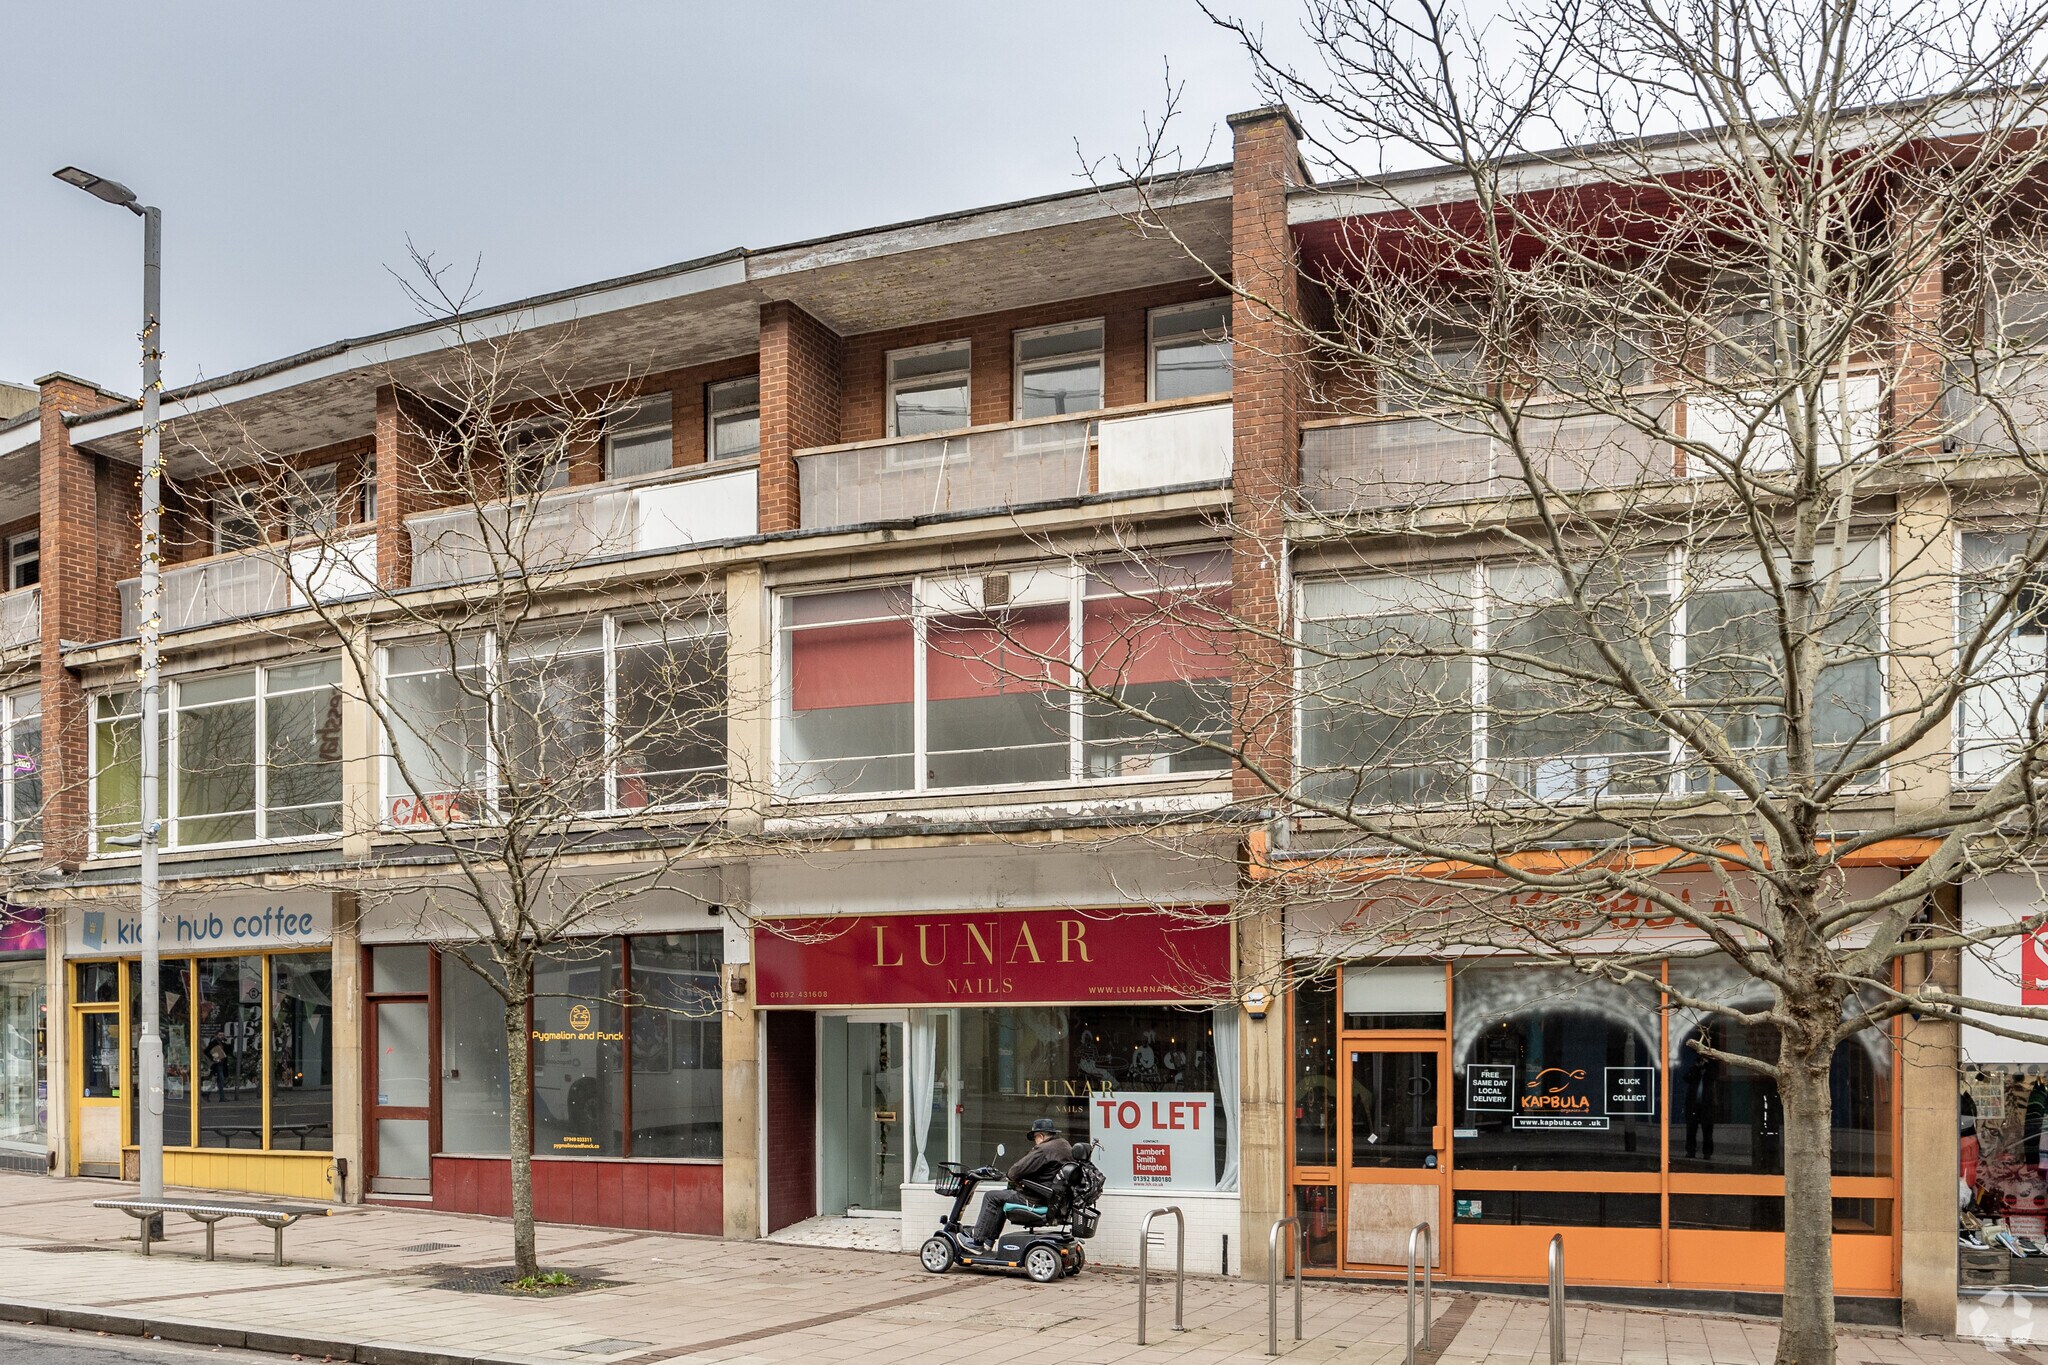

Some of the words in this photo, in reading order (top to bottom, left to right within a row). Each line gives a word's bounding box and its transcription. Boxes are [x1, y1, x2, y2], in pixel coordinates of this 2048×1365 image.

[392, 793, 461, 825] CAFE
[177, 912, 223, 942] hub
[233, 905, 313, 938] coffee
[872, 919, 1094, 967] LUNAR
[947, 977, 1013, 994] NAILS
[532, 1031, 576, 1042] Pygmalion
[578, 1031, 595, 1040] and
[597, 1031, 624, 1041] Funck
[1472, 1079, 1493, 1087] SAME
[1026, 1080, 1115, 1098] LUNAR
[1478, 1087, 1502, 1095] LOCAL
[1473, 1095, 1507, 1103] DELIVERY
[1521, 1095, 1590, 1109] KAPBULA
[1056, 1105, 1083, 1113] NAILS
[1096, 1100, 1142, 1130] TO
[1152, 1101, 1207, 1130] LET
[1519, 1118, 1583, 1126] www.kapbula.co
[1136, 1147, 1166, 1156] Lambert
[1136, 1163, 1168, 1172] Hampton
